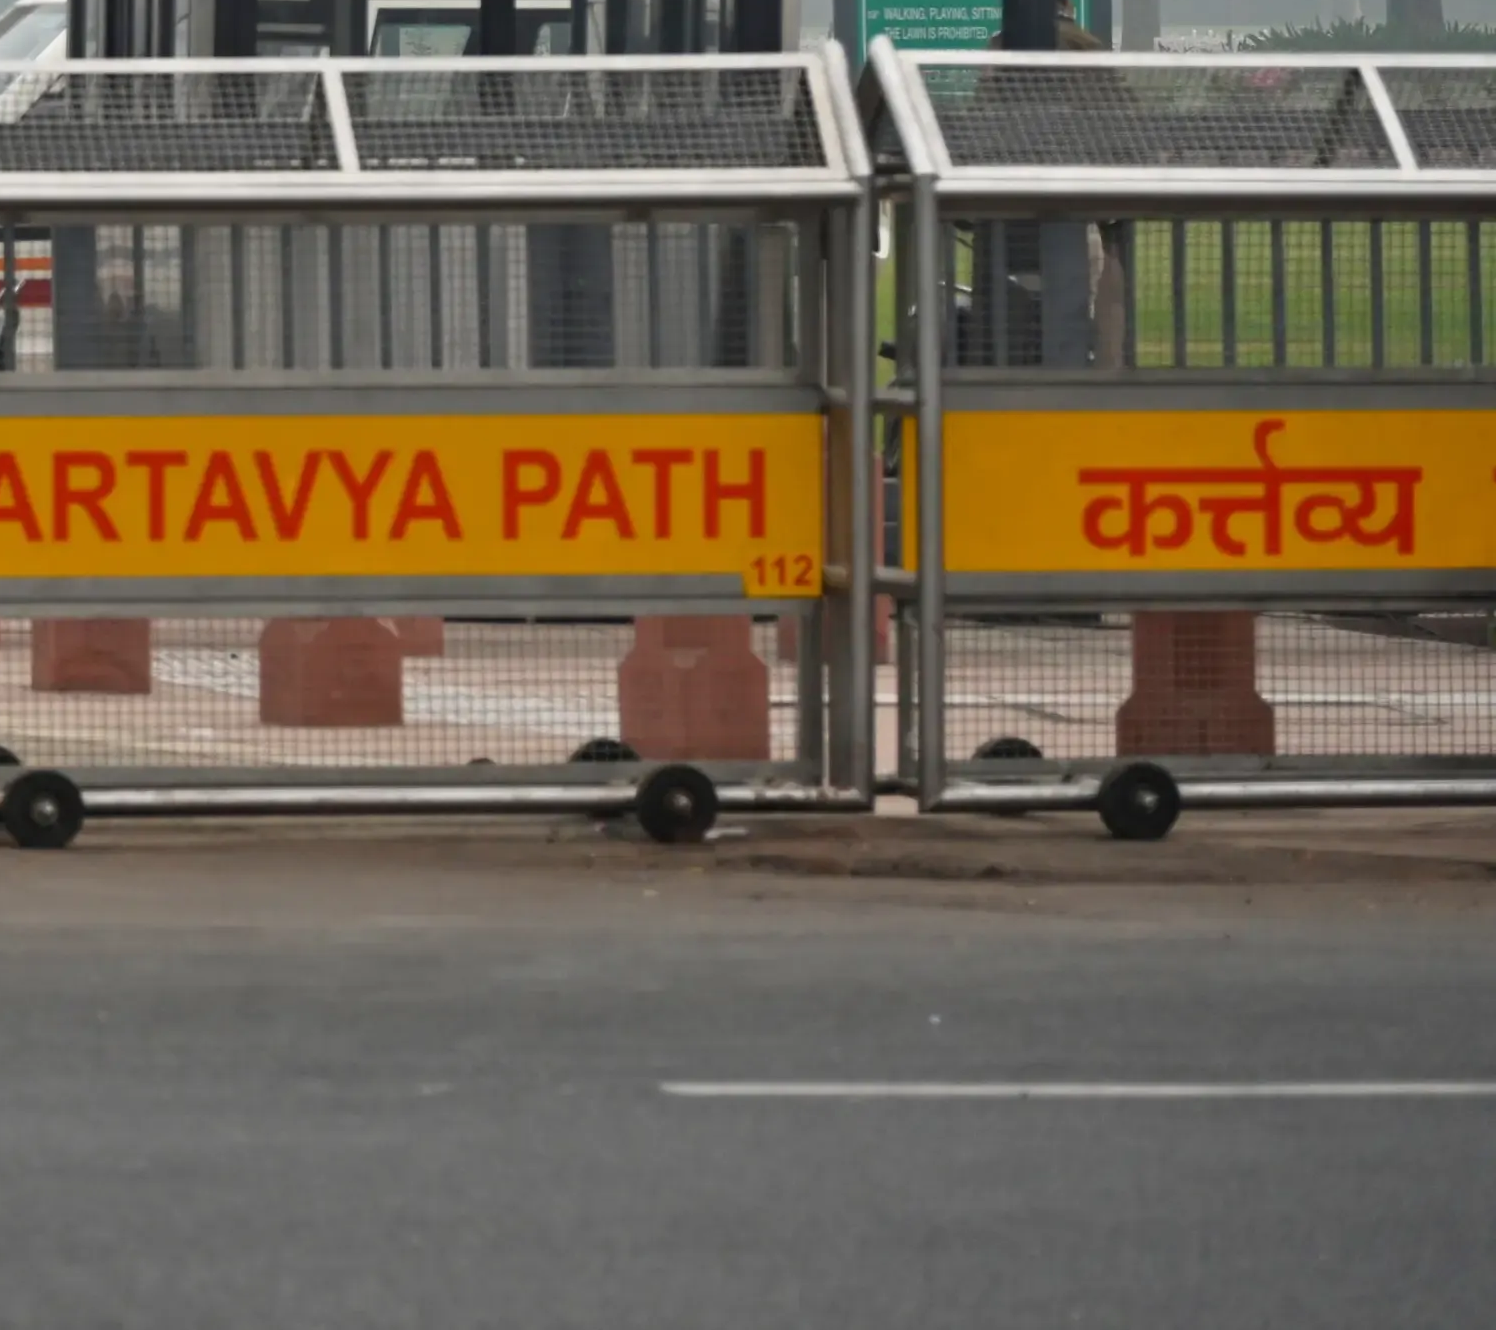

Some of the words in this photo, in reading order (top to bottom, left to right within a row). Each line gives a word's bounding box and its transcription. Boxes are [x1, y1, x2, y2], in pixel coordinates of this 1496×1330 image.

[930, 6, 970, 21] PLAYING,
[902, 26, 927, 40] LAWN
[928, 26, 937, 40] IS
[502, 448, 766, 540] PATH
[749, 553, 814, 587] 112
